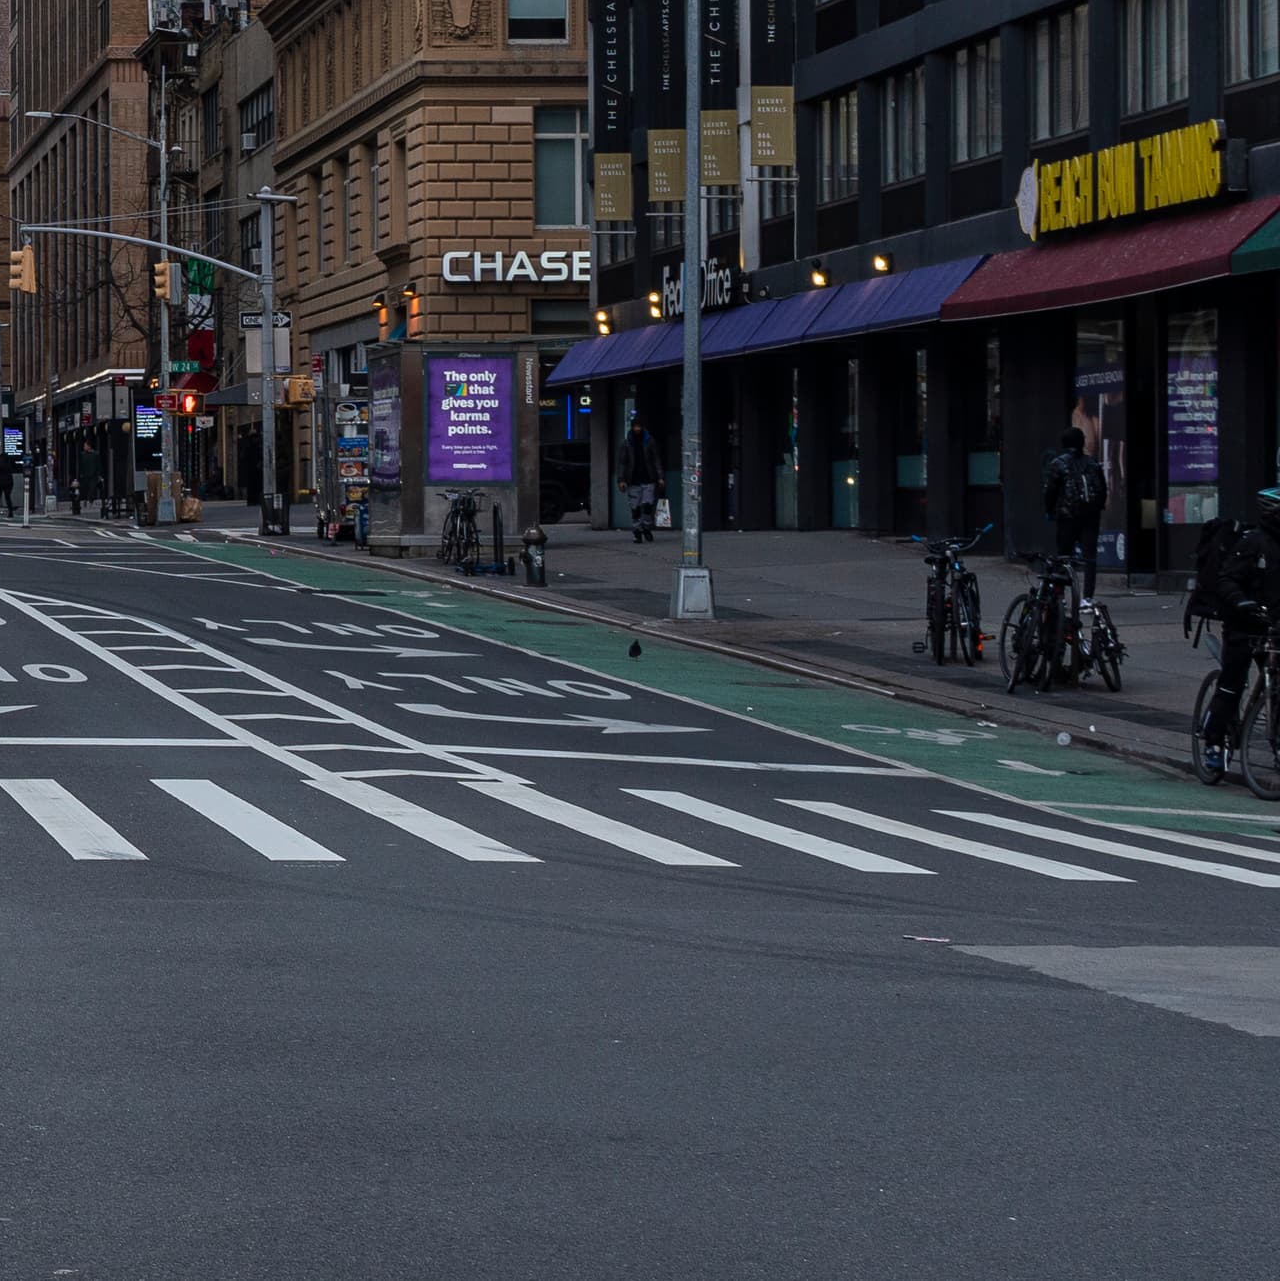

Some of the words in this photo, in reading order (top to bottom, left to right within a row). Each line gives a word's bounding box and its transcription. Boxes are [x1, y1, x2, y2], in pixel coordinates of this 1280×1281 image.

[1039, 152, 1094, 234] BEACH
[1097, 140, 1137, 221] BUM
[1139, 118, 1222, 211] TANNING
[442, 250, 590, 282] CHASE
[244, 316, 263, 324] ONE
[443, 370, 468, 382] The
[469, 370, 497, 383] only
[469, 384, 495, 395] that
[441, 397, 474, 410] gives
[476, 399, 499, 410] you
[450, 410, 490, 422] karma
[448, 423, 492, 437] points.
[192, 617, 441, 640] ONLY
[323, 670, 632, 701] ONLY
